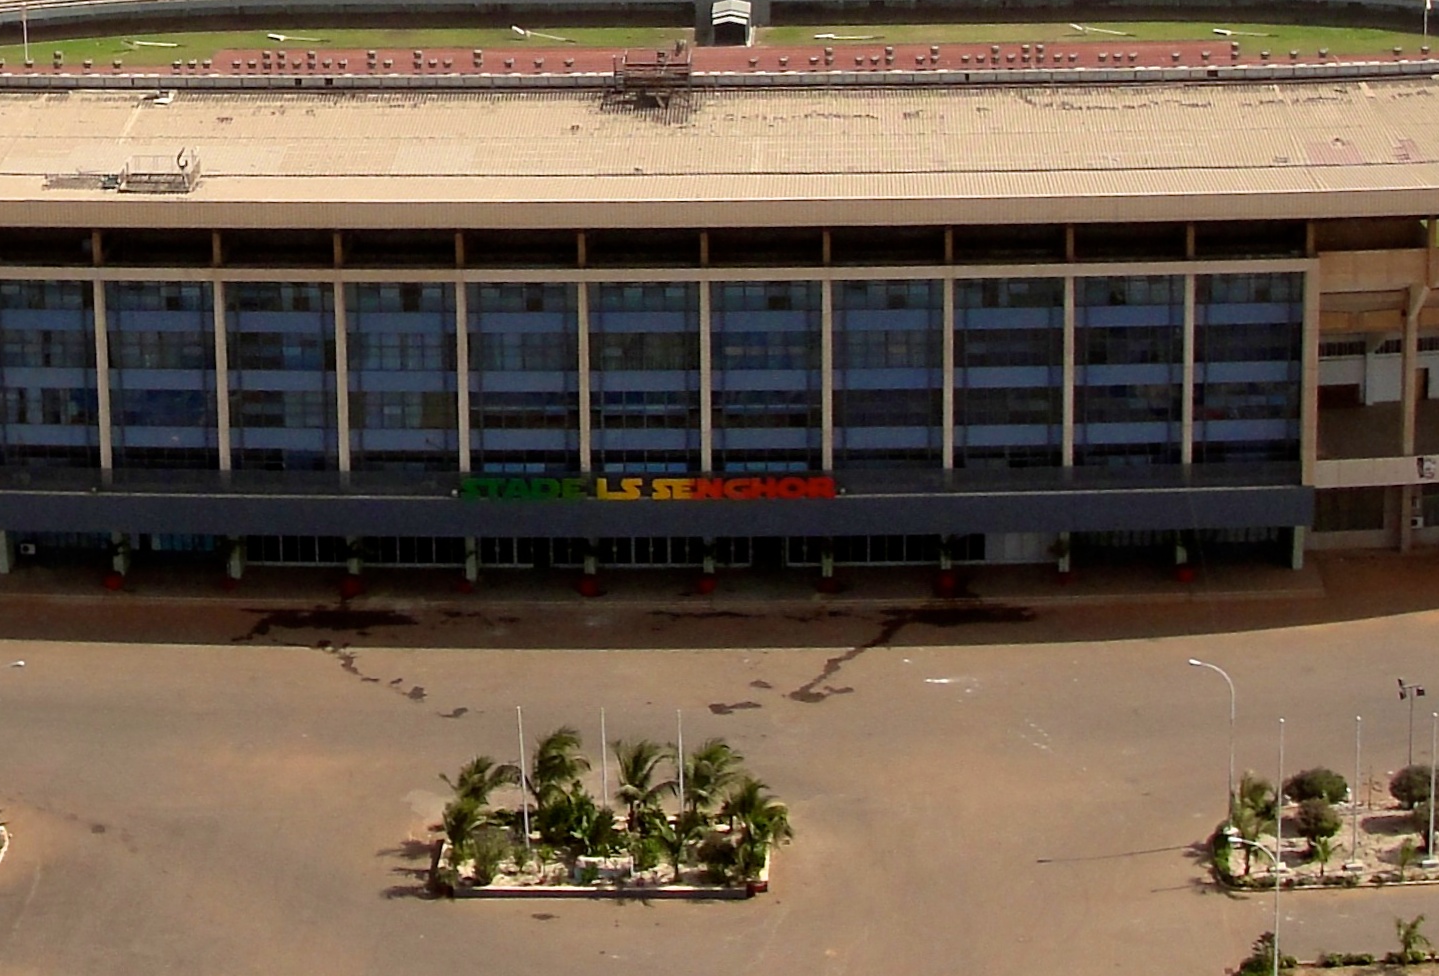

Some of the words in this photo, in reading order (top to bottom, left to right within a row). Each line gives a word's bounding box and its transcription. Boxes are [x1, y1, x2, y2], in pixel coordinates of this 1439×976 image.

[462, 477, 587, 501] STADE
[596, 478, 643, 500] LS
[652, 477, 835, 500] SENGHOR
